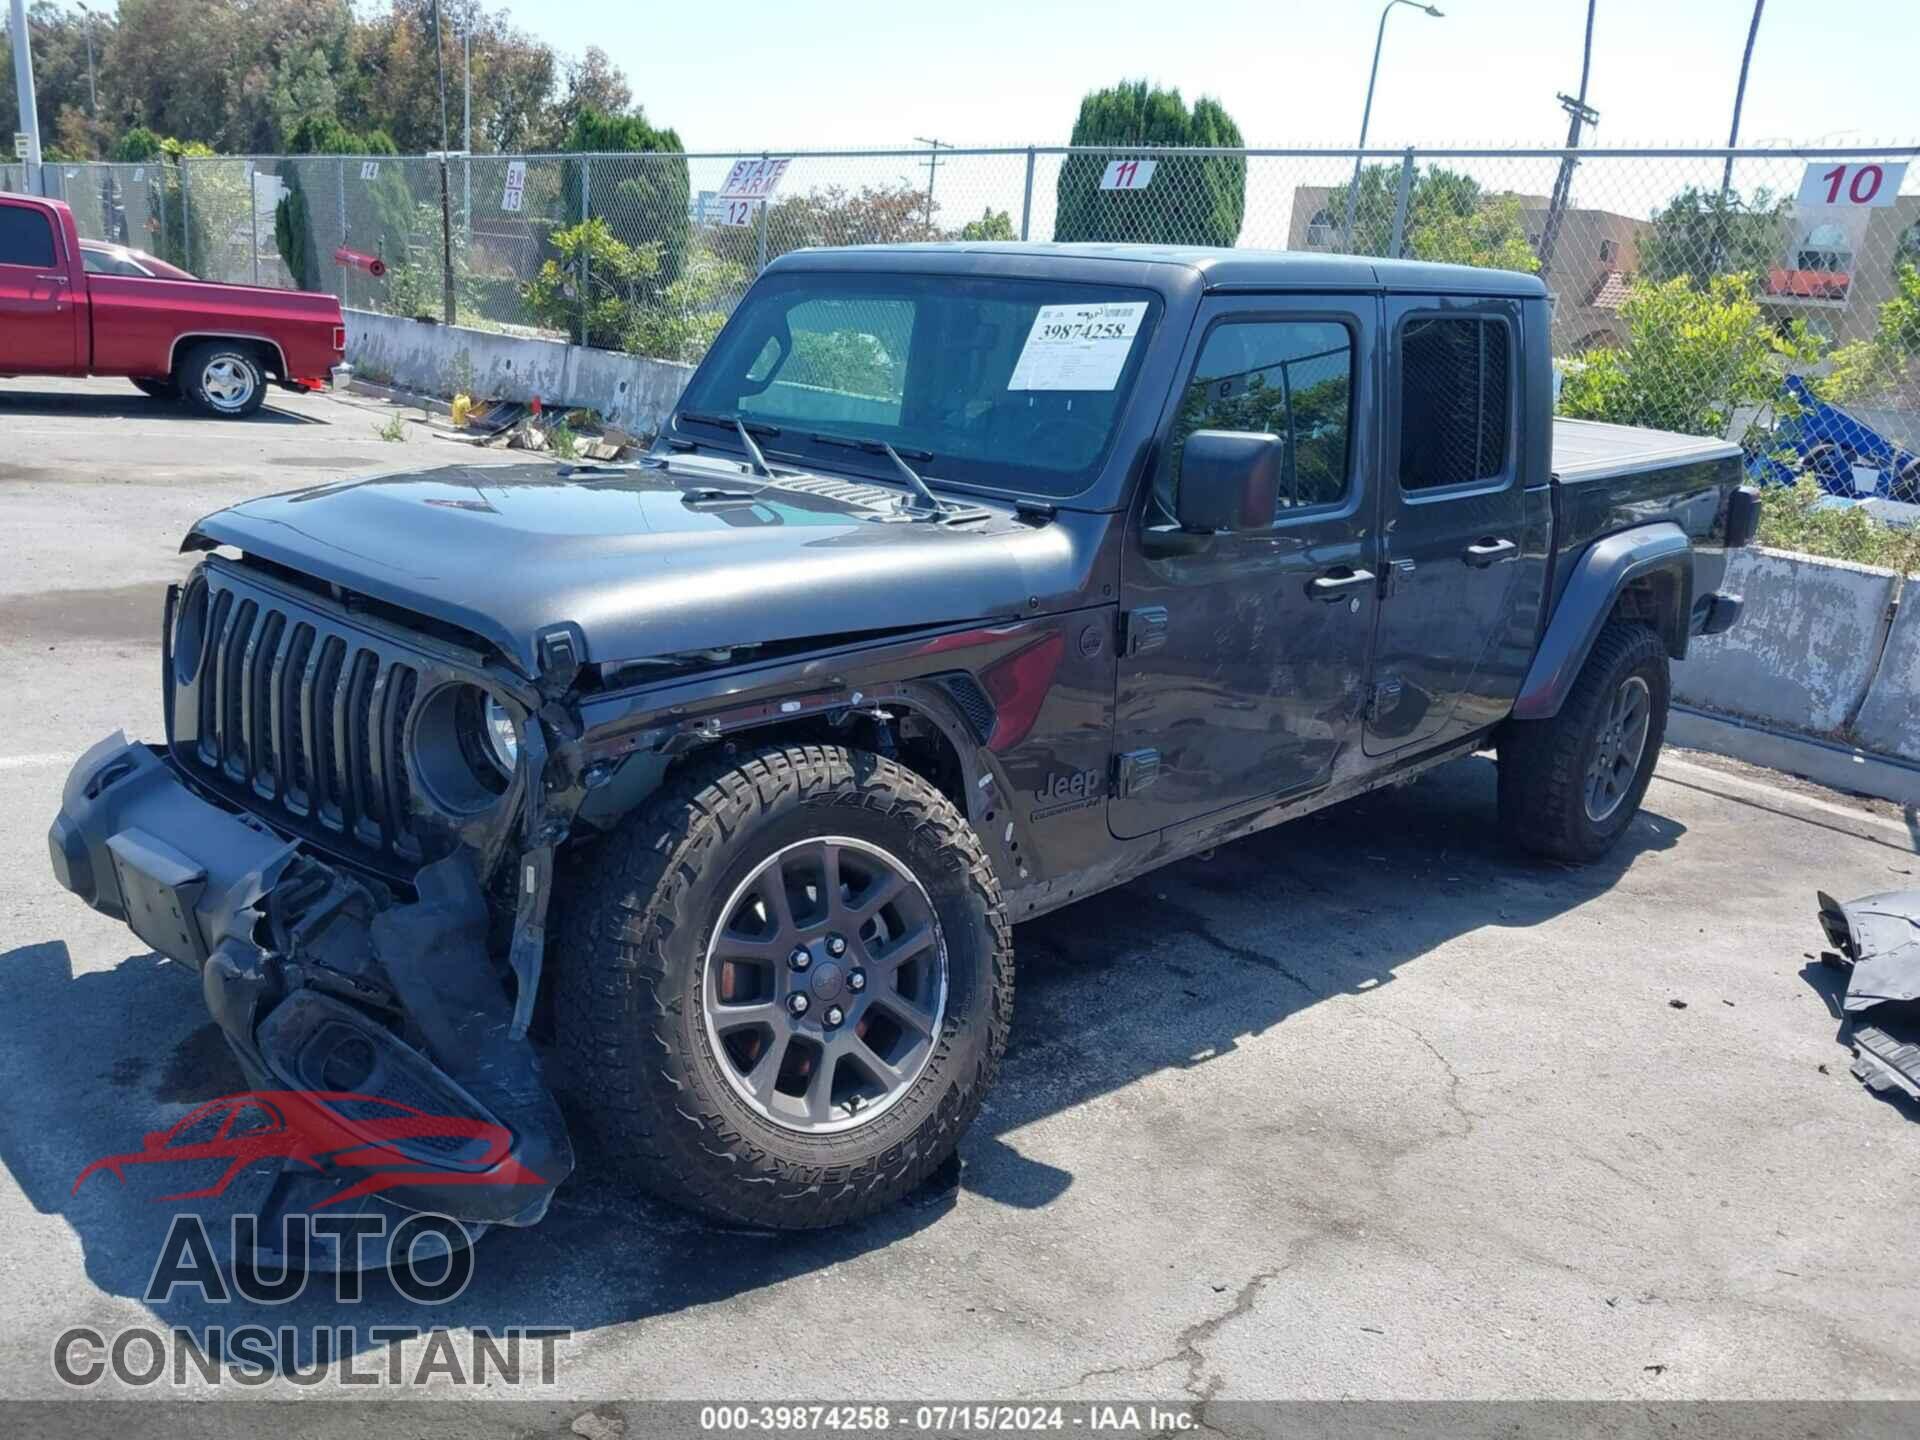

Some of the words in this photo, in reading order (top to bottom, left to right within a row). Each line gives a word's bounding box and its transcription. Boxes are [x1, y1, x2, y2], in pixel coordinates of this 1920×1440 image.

[733, 159, 791, 177] STATE
[1115, 160, 1139, 187] 11
[725, 177, 777, 193] FARM
[1823, 165, 1883, 204] 10
[506, 191, 519, 208] 13
[728, 202, 748, 224] 12
[1038, 323, 1126, 340] 39874258
[1036, 769, 1098, 802] Jeep
